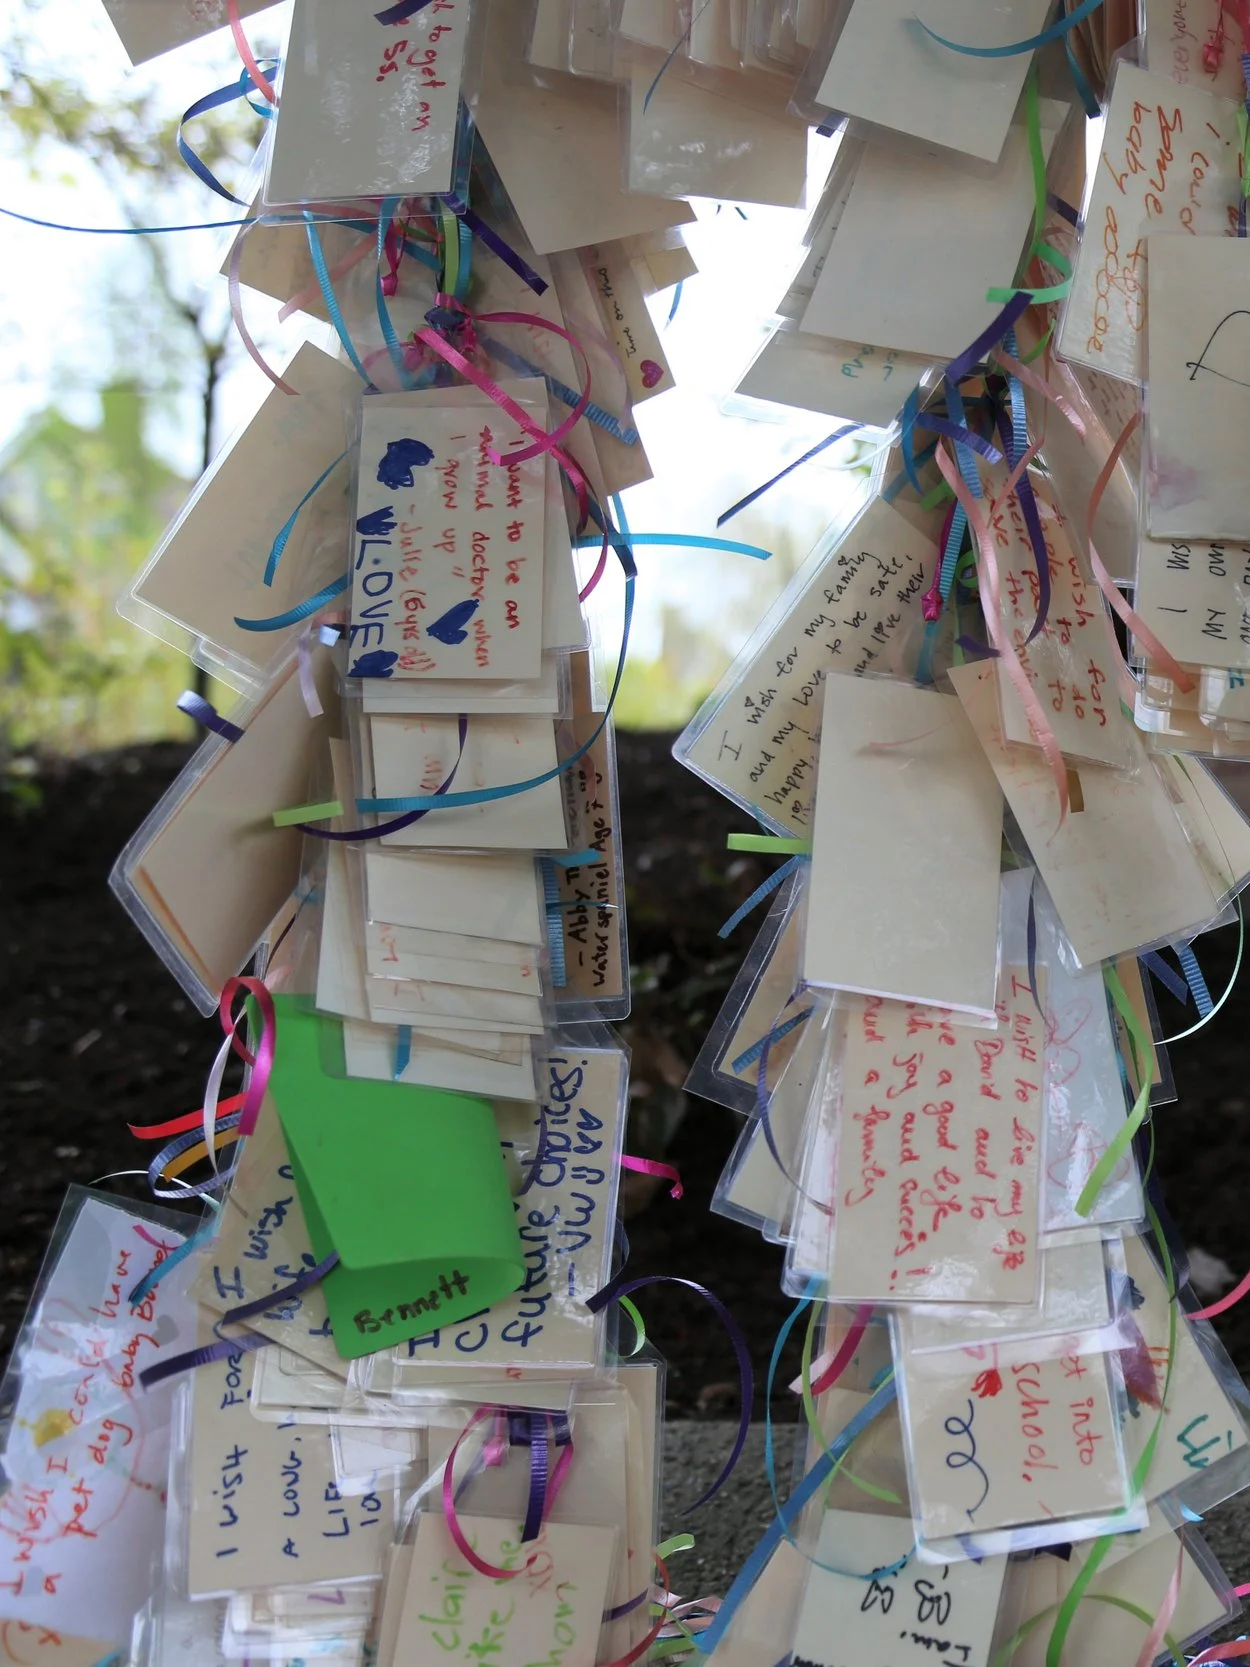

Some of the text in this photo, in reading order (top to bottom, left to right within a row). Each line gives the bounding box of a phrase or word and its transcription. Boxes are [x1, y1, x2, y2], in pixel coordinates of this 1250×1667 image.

[428, 25, 454, 42] to
[406, 48, 447, 89] get
[411, 101, 431, 132] an
[506, 520, 526, 543] to
[470, 531, 491, 600] doctor
[505, 556, 528, 586] be
[1166, 543, 1192, 571] WIS
[505, 599, 521, 630] an
[1005, 571, 1025, 620] the
[472, 618, 490, 668] when
[1067, 556, 1106, 727] wish for
[1201, 608, 1228, 641] MY
[718, 550, 883, 762] I wish for my family
[1056, 617, 1085, 720] to do
[750, 752, 776, 784] and
[771, 720, 811, 746] my
[826, 638, 843, 656] to
[843, 610, 868, 630] be
[1049, 679, 1064, 713] to
[566, 888, 591, 944] Abby
[864, 1068, 880, 1087] a
[936, 1068, 953, 1089] a
[1013, 1077, 1039, 1103] to
[900, 1111, 921, 1167] and
[922, 1100, 959, 1152] good
[970, 1038, 1005, 1221] David and to
[993, 1179, 1024, 1218] my
[213, 1264, 246, 1300] I
[500, 1204, 561, 1348] future
[352, 1268, 471, 1335] Bennett
[1069, 1396, 1104, 1467] into
[42, 1572, 63, 1594] a
[64, 1479, 98, 1539] pet
[88, 1416, 134, 1465] dog
